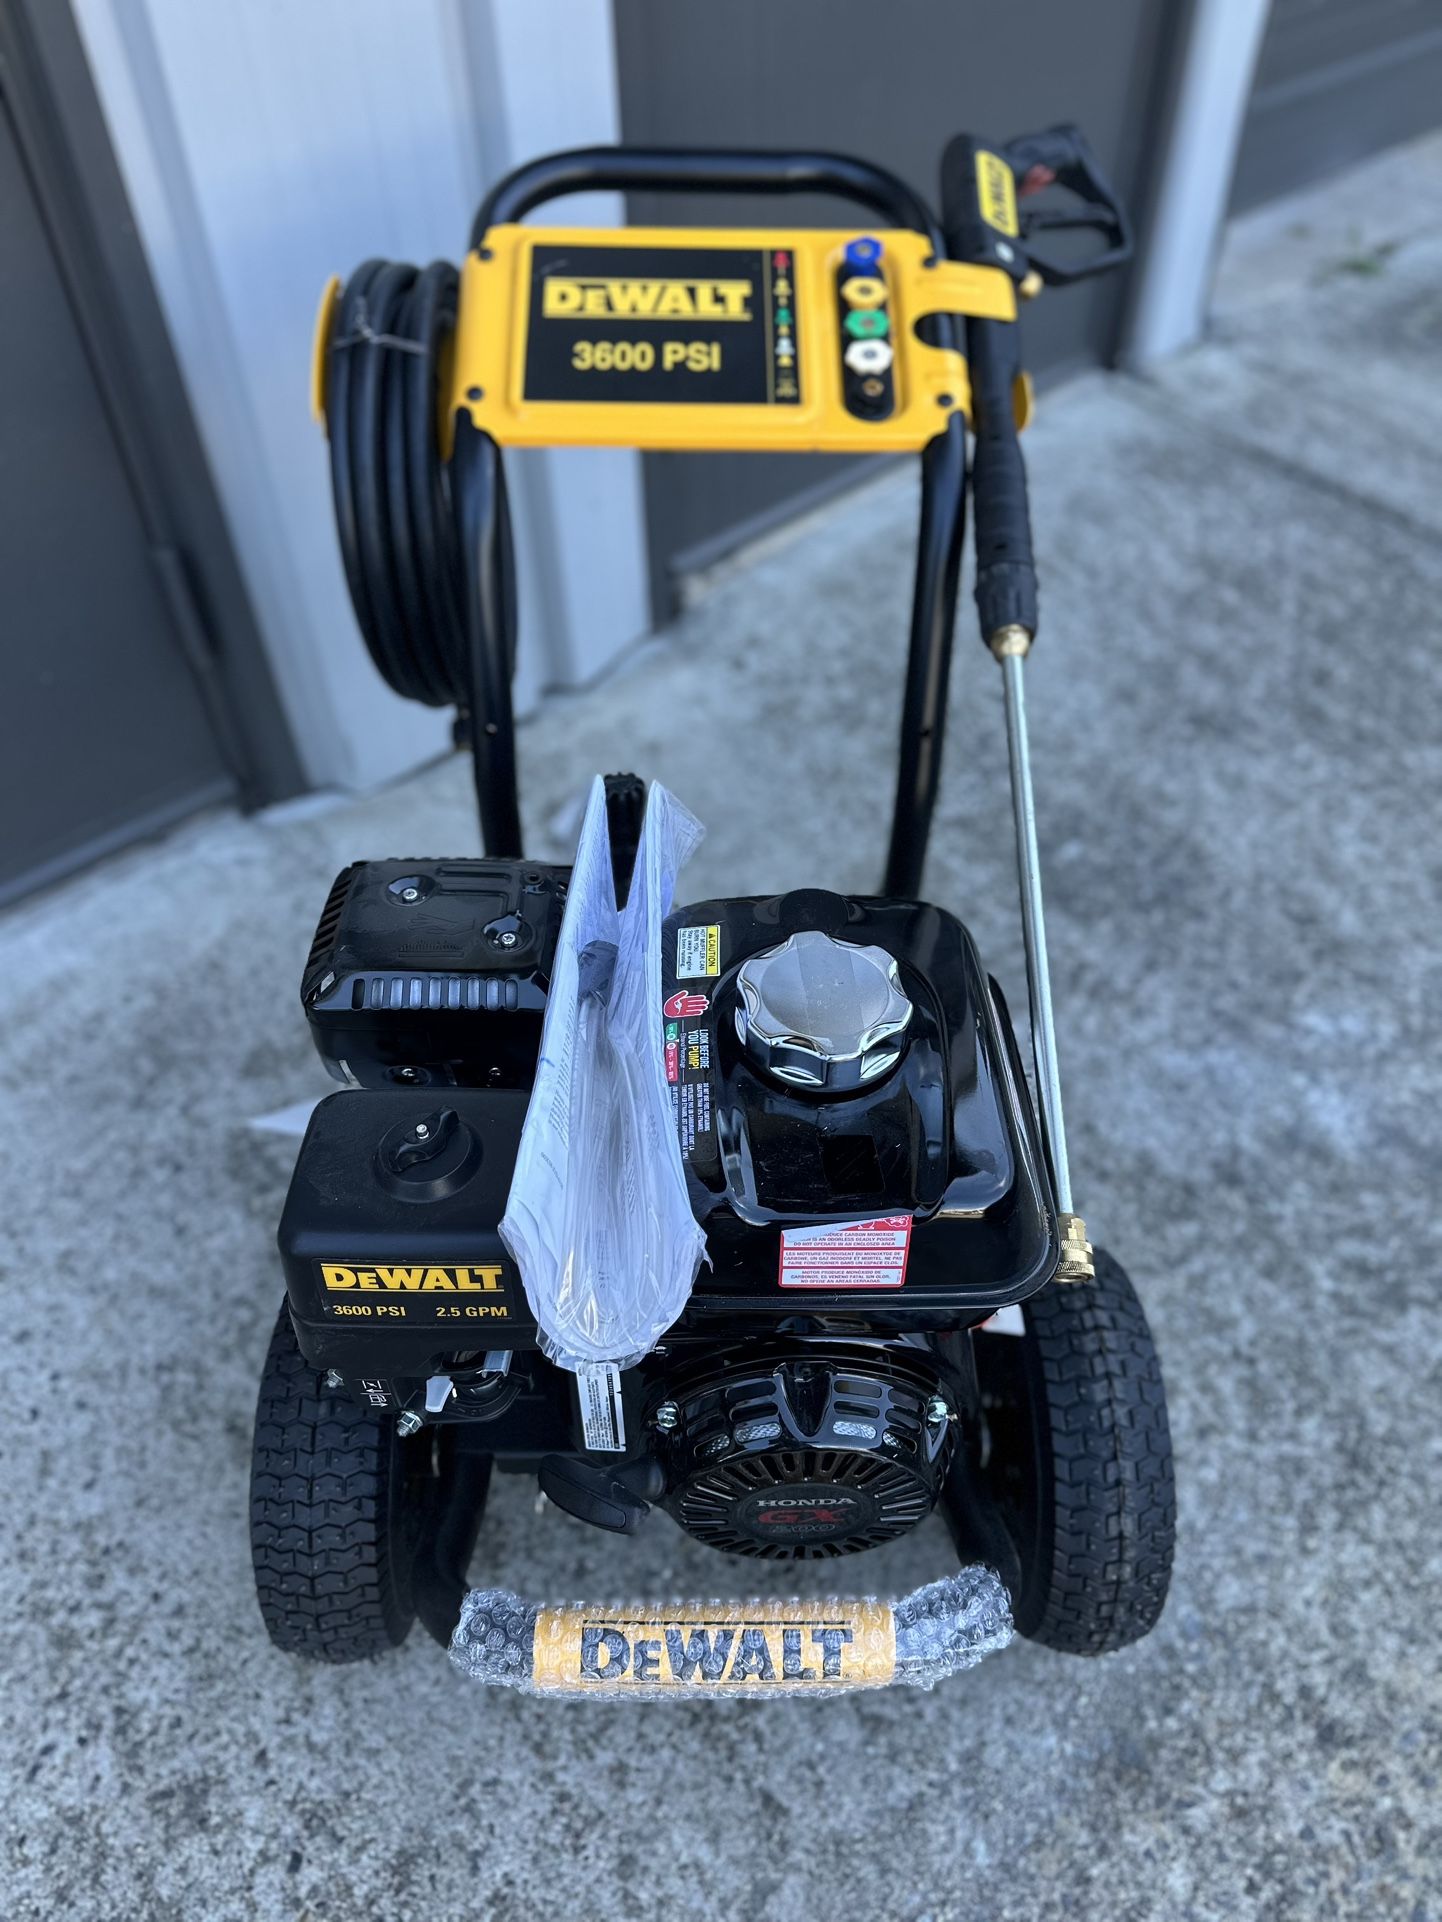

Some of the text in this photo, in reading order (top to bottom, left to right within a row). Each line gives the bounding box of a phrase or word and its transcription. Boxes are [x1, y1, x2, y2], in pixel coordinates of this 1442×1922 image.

[544, 280, 752, 318] DEWALT
[572, 341, 721, 372] 3600 PSI
[708, 939, 716, 967] CAUTION
[688, 1030, 699, 1070] YOU PUMP!
[700, 1029, 709, 1069] LOOK BEFORE
[322, 1266, 503, 1290] DEWALT
[333, 1305, 406, 1316] 3600 PSI
[436, 1306, 508, 1317] 2.5 GPM
[757, 1498, 857, 1506] HONDA
[758, 1508, 849, 1523] GX
[580, 1627, 853, 1681] DEWALT
